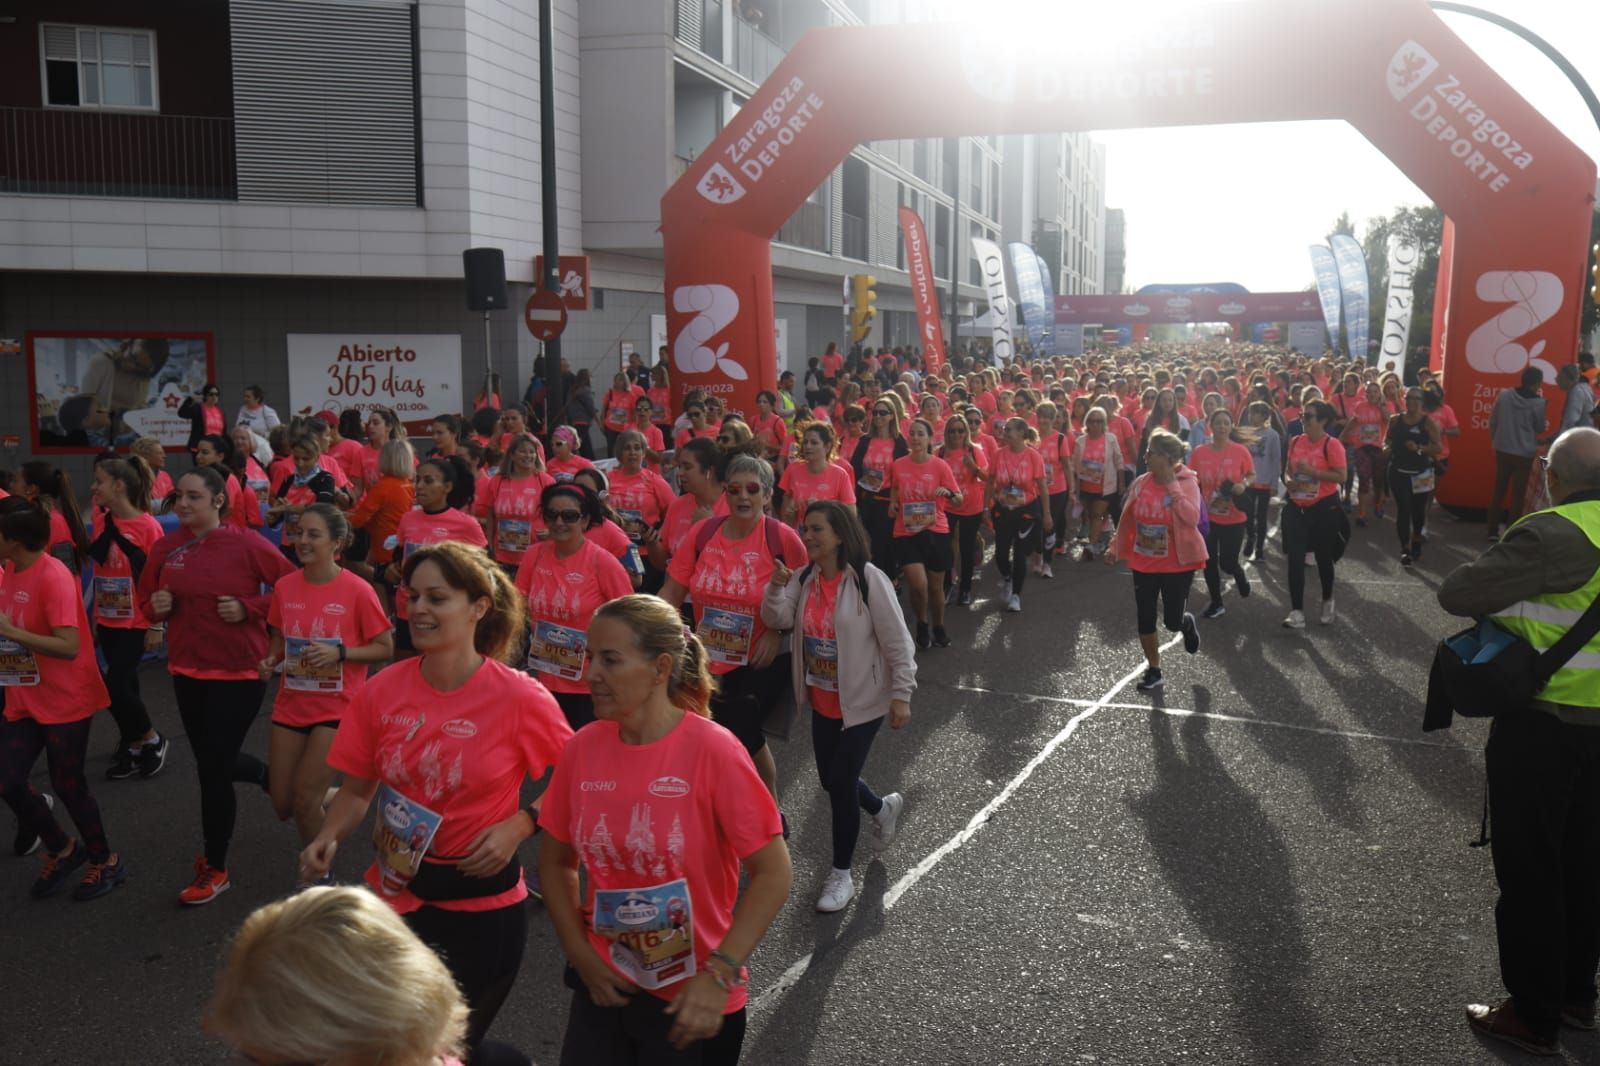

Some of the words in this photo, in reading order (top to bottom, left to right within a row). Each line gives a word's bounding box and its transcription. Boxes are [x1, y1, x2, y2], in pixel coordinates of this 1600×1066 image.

[724, 74, 805, 163] Zaragoza
[1433, 73, 1535, 171] Zaragoza
[741, 92, 825, 183] DEPORTE
[1408, 95, 1512, 194] DEPORTE
[337, 344, 417, 363] Abierto
[327, 364, 376, 397] 365
[1473, 383, 1544, 397] Zara
[545, 644, 568, 657] 016
[709, 629, 733, 642] 016
